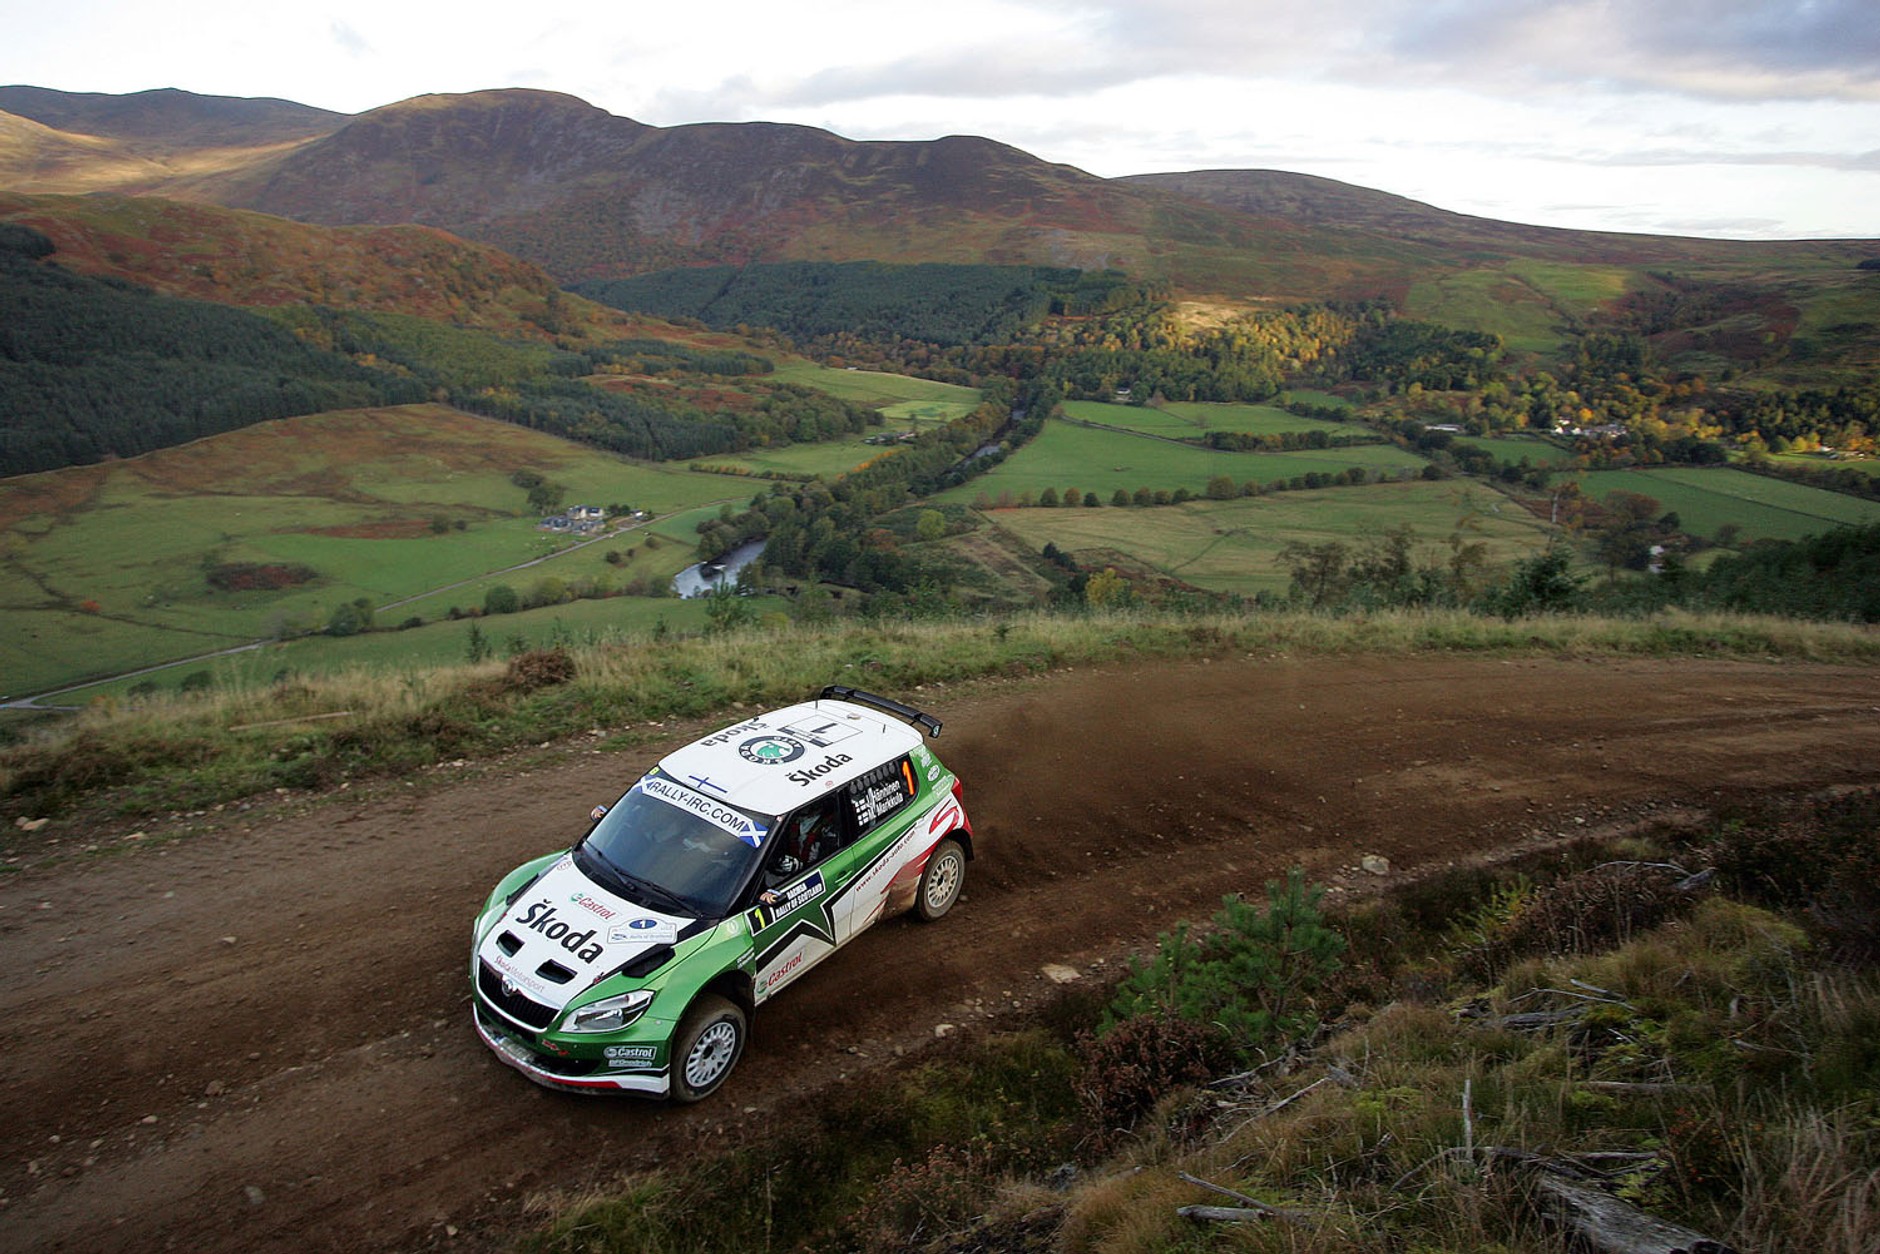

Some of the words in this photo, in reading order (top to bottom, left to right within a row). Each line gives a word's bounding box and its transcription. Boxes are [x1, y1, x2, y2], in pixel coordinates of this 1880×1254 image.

[785, 753, 853, 787] Škoda
[902, 760, 915, 795] 1
[649, 781, 746, 831] RALLY-IRC.COM
[579, 896, 617, 920] Castrol
[775, 903, 792, 918] RALLY
[790, 899, 799, 910] OF
[797, 883, 823, 905] SCOTLAND
[515, 898, 605, 965] Škoda
[639, 920, 647, 929] 1
[754, 908, 766, 929] 1
[768, 951, 803, 986] Castrol
[618, 1048, 653, 1058] Castrol
